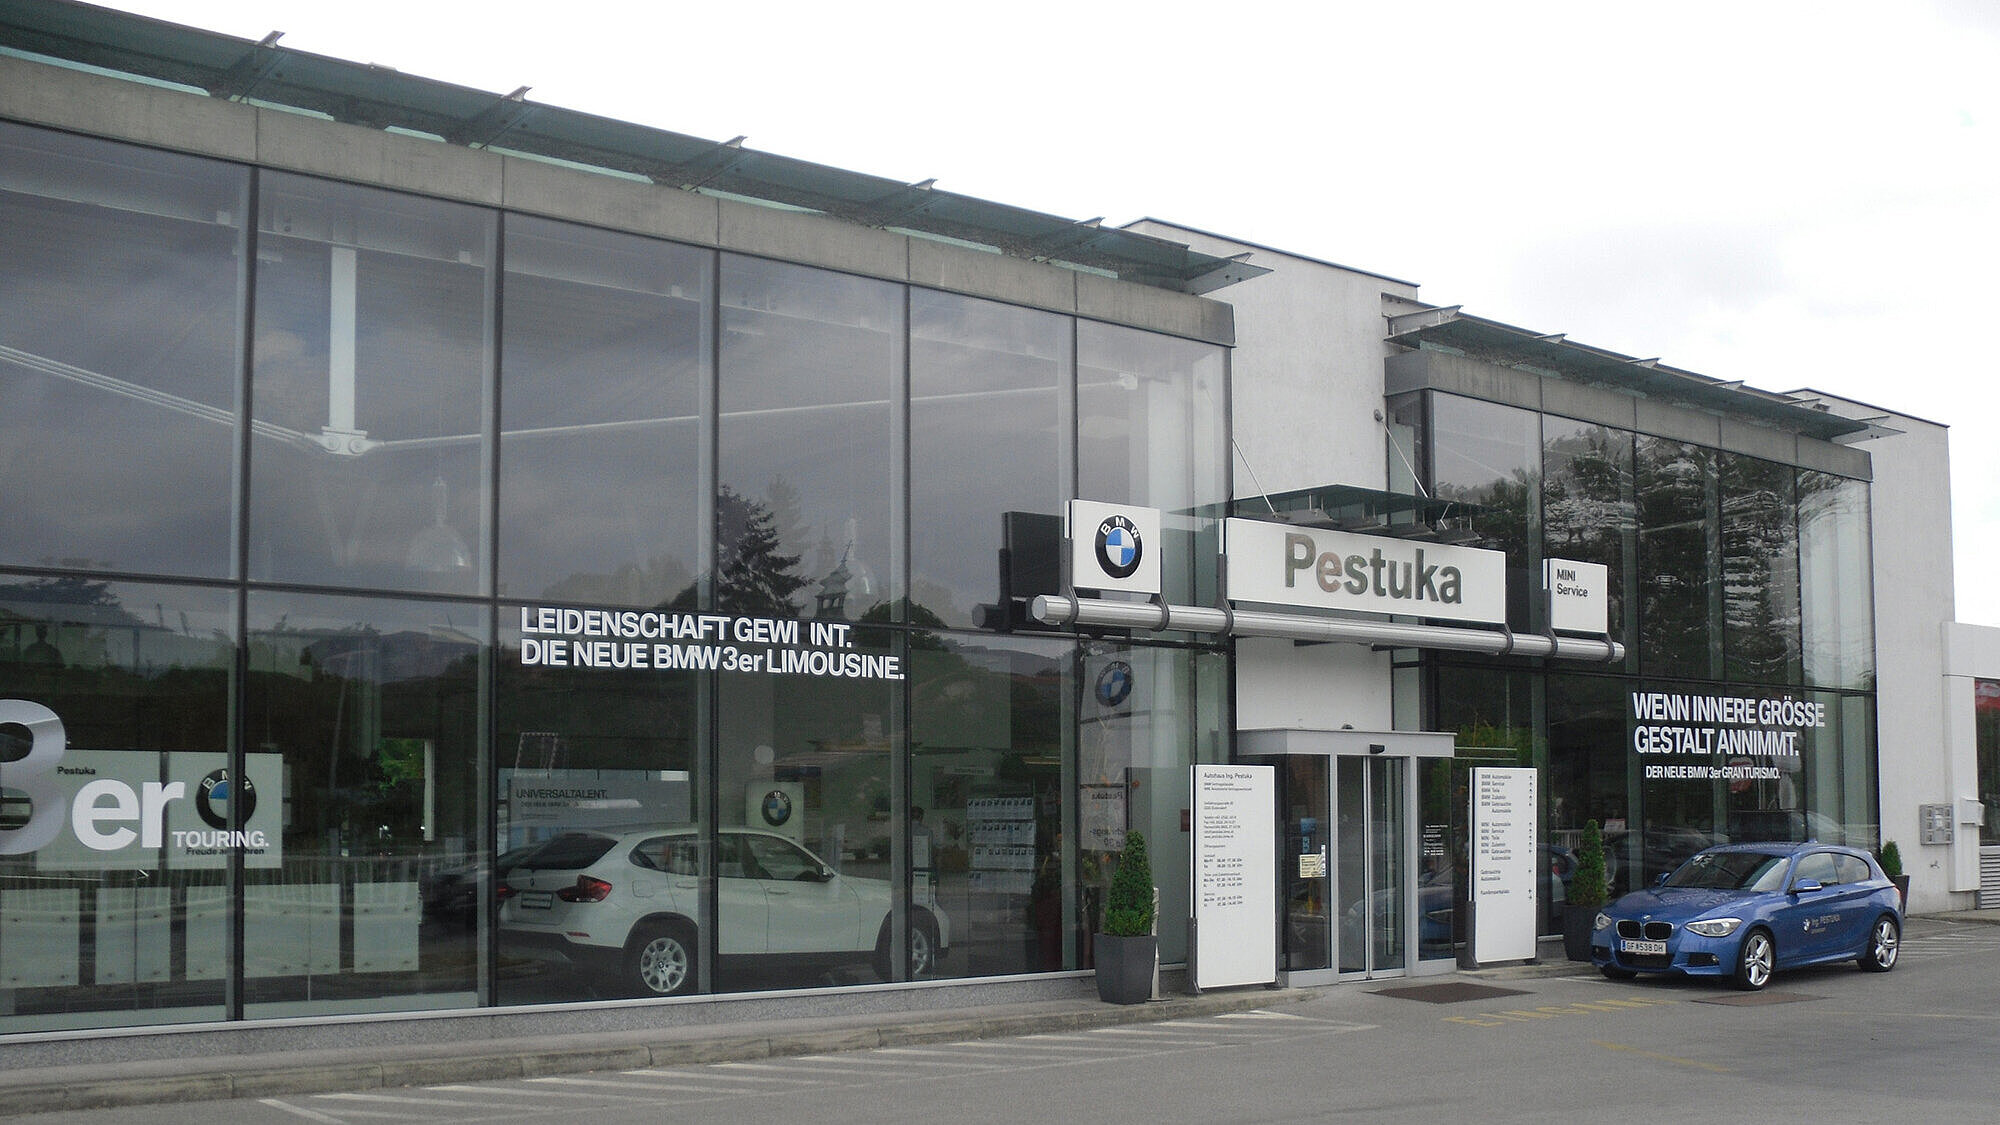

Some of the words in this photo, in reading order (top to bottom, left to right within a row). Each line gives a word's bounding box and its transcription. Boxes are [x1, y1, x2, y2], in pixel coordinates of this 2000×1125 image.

[1100, 516, 1139, 539] BMW
[1285, 532, 1462, 604] Pestuka
[1557, 569, 1576, 581] MINI
[1557, 583, 1589, 597] Service
[521, 607, 731, 640] LEIDENSCHAFT
[521, 639, 567, 666] DIE
[573, 641, 648, 668] NEUE
[654, 644, 720, 670] BMW
[722, 646, 763, 672] 3er
[766, 649, 905, 680] LIMOUSINE.
[1633, 692, 1690, 721] WENN
[1693, 695, 1757, 724] INNERE
[1758, 696, 1826, 727] GRÖSSE
[1634, 726, 1715, 754] GESTALT
[1716, 728, 1799, 756] ANNIMMT.
[57, 766, 96, 776] Pestuka
[1645, 766, 1663, 779] DER
[1664, 766, 1687, 779] NEUE
[1688, 766, 1709, 779] BMW
[1709, 767, 1722, 779] 3er
[1722, 767, 1744, 779] GRAN
[1744, 767, 1781, 780] TURISMO.
[516, 788, 608, 799] UNIVERSALTALENT.
[171, 830, 269, 848] TOURING.
